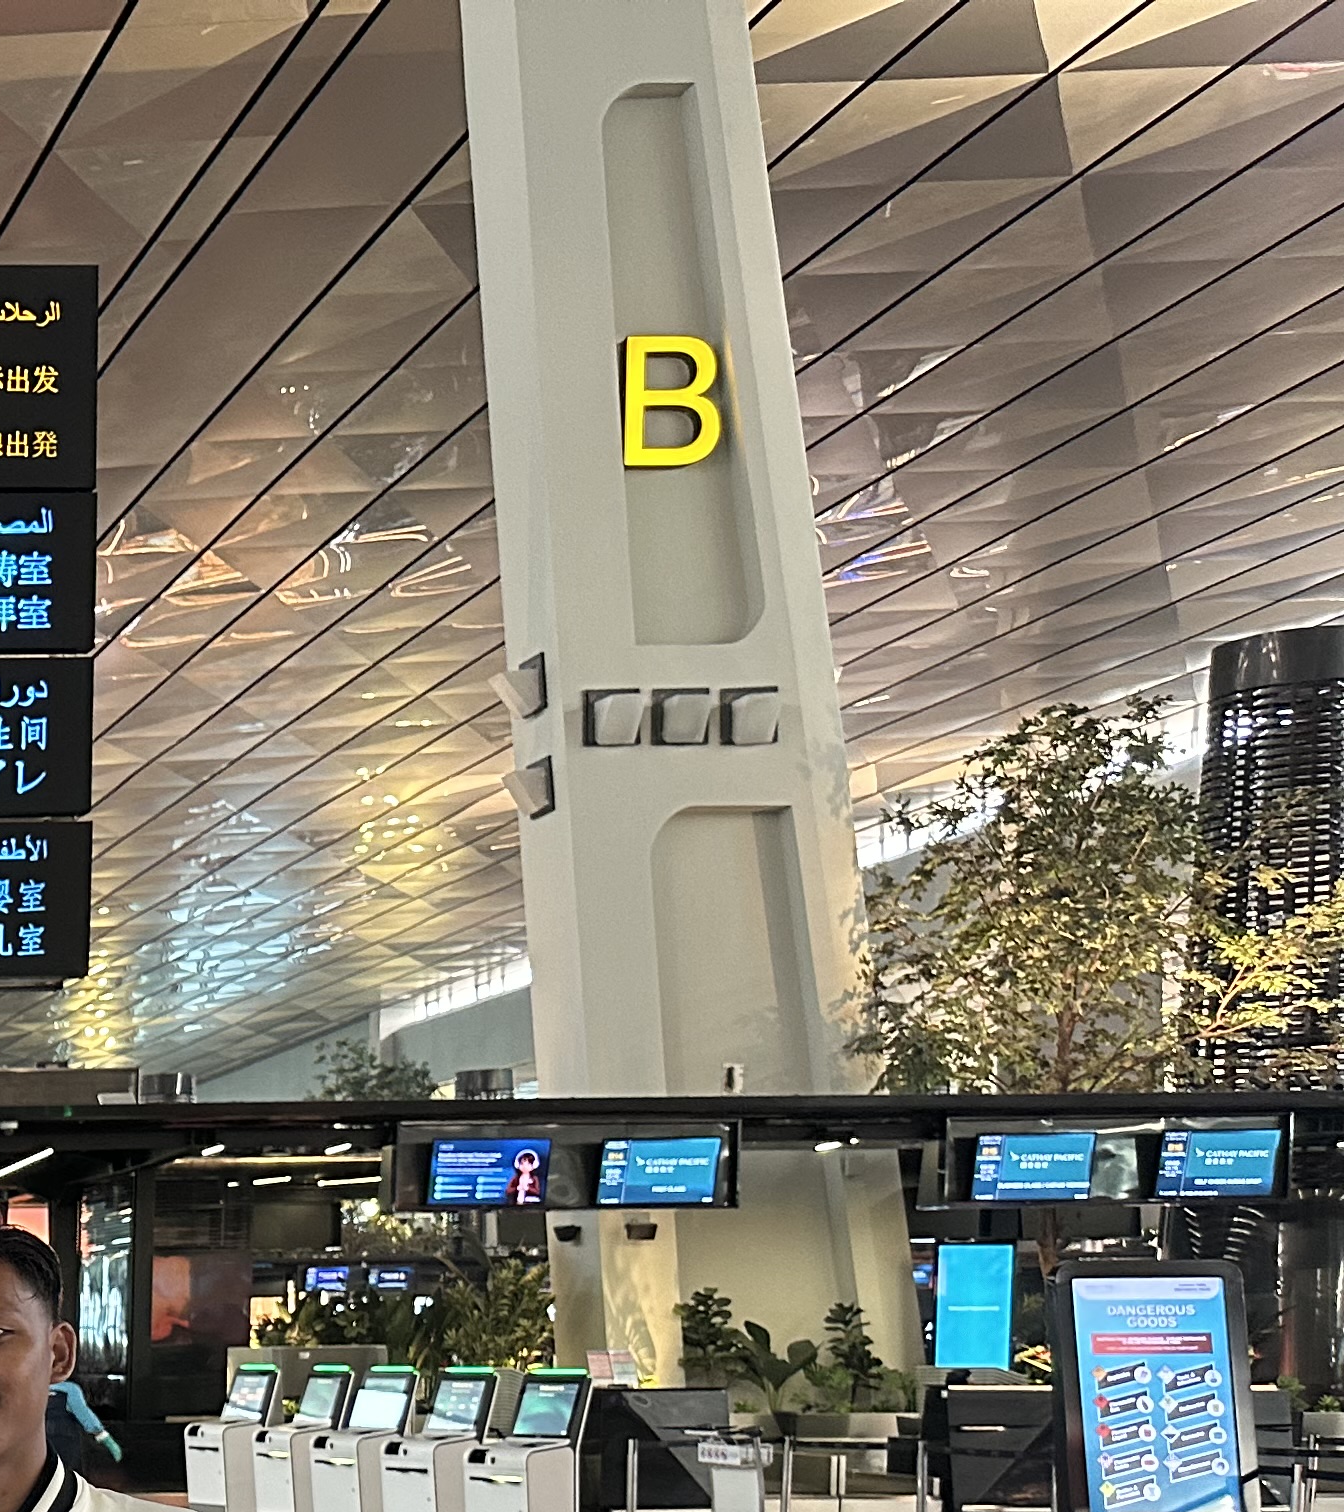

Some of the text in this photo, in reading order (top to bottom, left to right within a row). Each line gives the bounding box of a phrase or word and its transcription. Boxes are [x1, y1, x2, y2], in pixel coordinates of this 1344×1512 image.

[621, 335, 721, 470] B
[1106, 1304, 1196, 1316] DANGEROUS
[1126, 1316, 1178, 1328] GOODS
